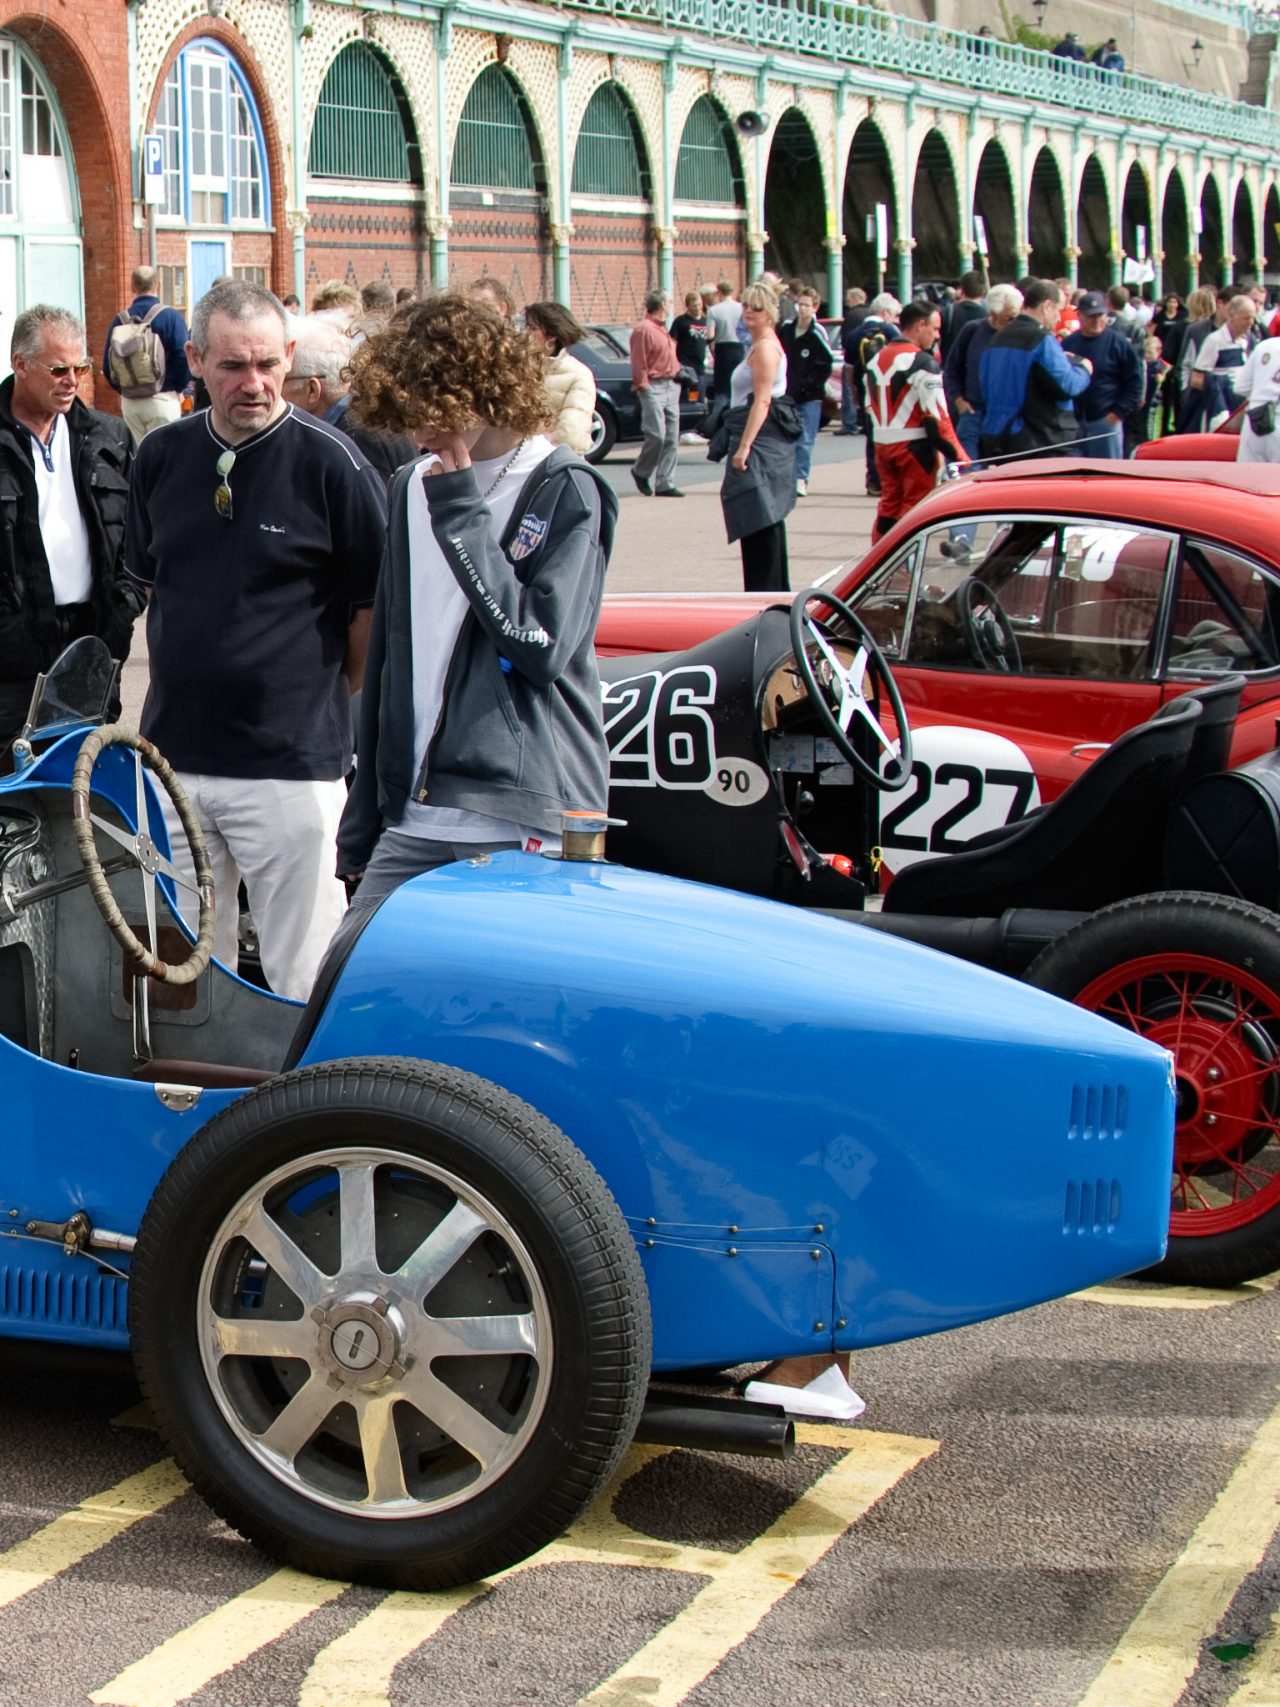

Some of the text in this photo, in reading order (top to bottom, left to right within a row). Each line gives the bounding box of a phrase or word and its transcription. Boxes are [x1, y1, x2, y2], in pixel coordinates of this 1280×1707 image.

[148, 140, 162, 174] P
[600, 664, 718, 790] 26
[718, 769, 750, 793] 90
[881, 760, 1035, 854] 227
